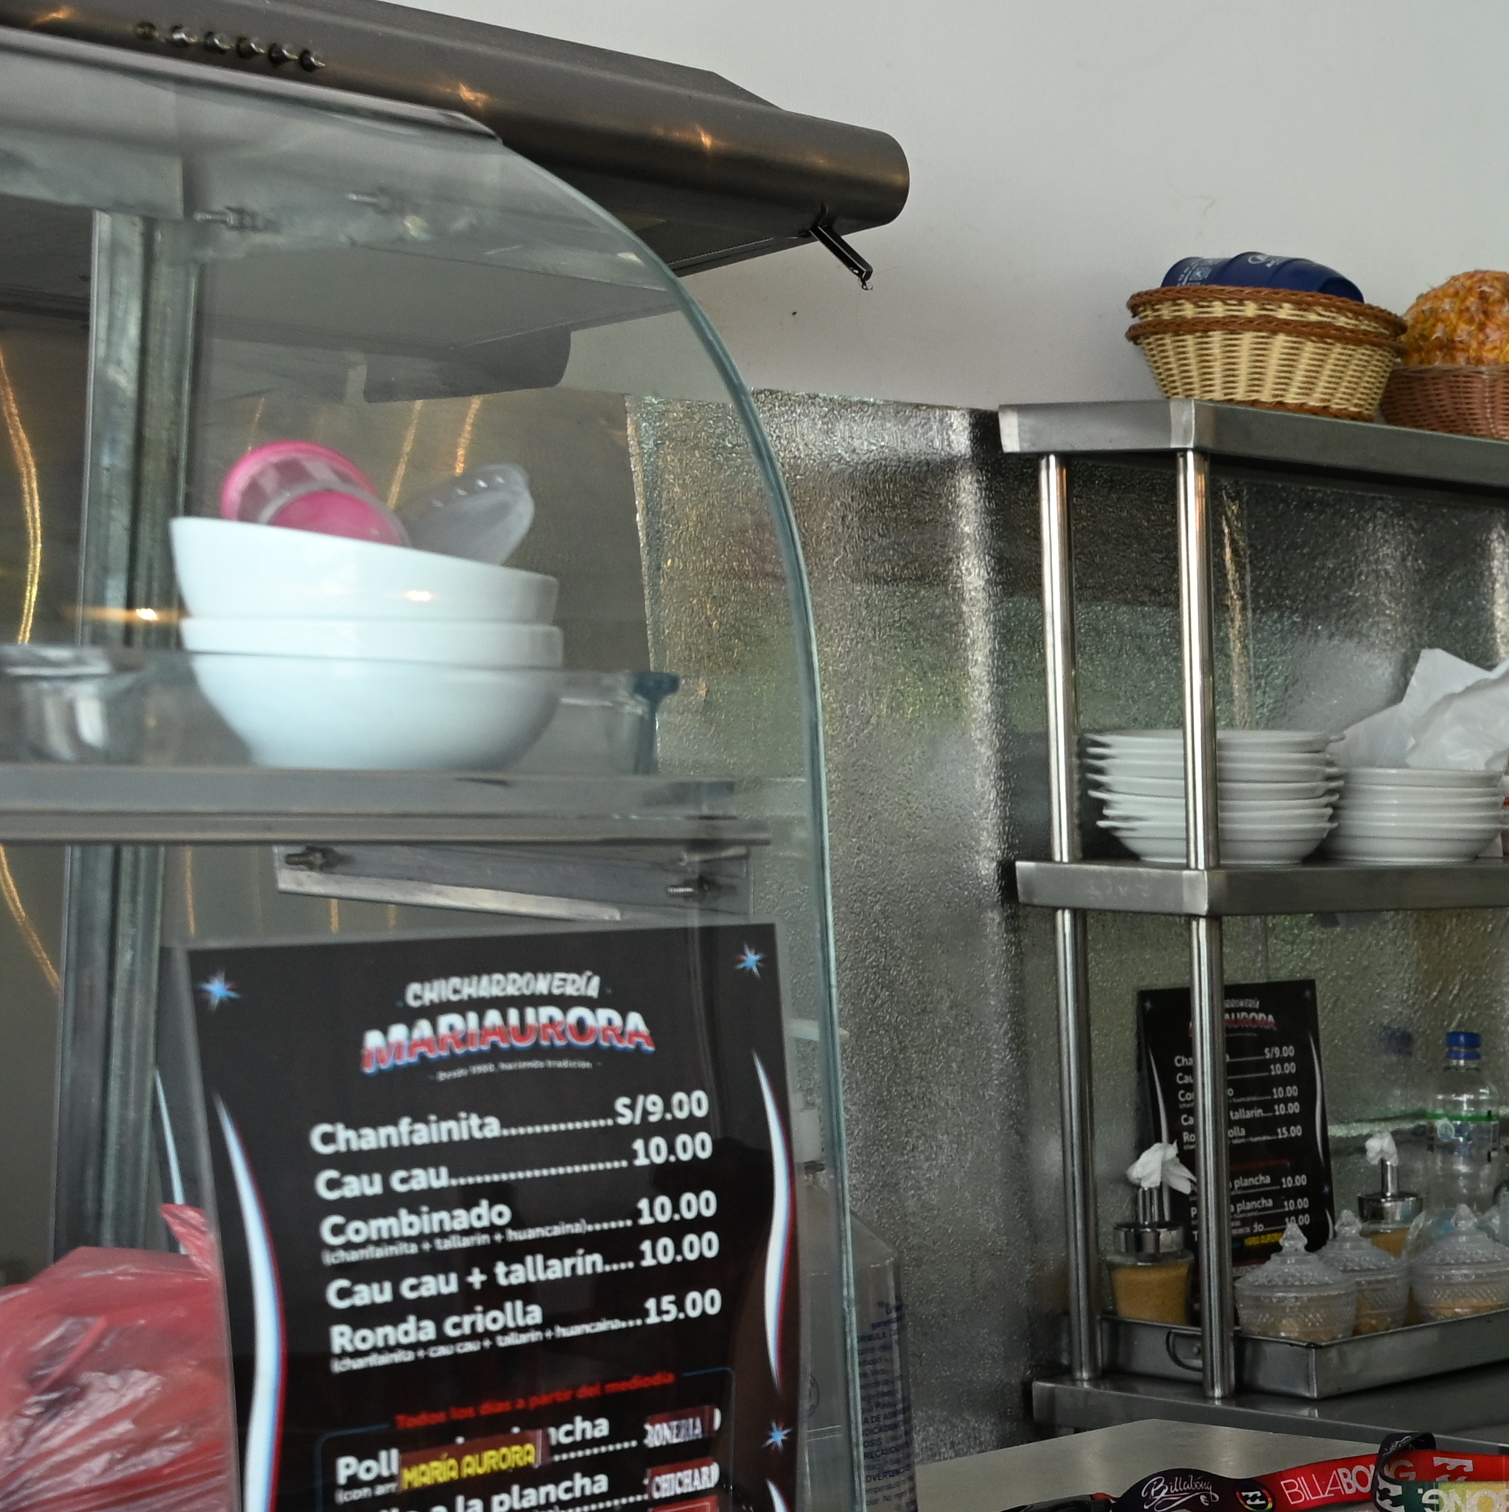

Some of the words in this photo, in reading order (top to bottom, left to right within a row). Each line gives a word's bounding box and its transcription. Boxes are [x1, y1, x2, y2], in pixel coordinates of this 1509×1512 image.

[361, 1005, 656, 1075] MARIAURORA
[1264, 1045, 1296, 1060] S/9.00
[1270, 1062, 1297, 1076] 10.00
[1272, 1085, 1299, 1099] 10.00
[1274, 1102, 1300, 1116] 10.00
[309, 1111, 501, 1155] Chanfainita
[614, 1089, 709, 1125] S/9.00
[1277, 1125, 1303, 1139] 15.00
[314, 1168, 384, 1200] Cau
[389, 1165, 449, 1192] cau
[632, 1131, 713, 1166] 10.00
[1234, 1174, 1271, 1189] plancha
[1281, 1174, 1307, 1189] 10.00
[319, 1198, 512, 1246] Combinado
[637, 1190, 717, 1225] 10.00
[1236, 1197, 1273, 1214] plancha
[1284, 1197, 1309, 1212] 10.00
[325, 1278, 393, 1309] Cau
[400, 1272, 459, 1299] cau
[466, 1267, 488, 1290] +
[640, 1231, 719, 1267] 10.00
[644, 1288, 722, 1325] 15.00
[329, 1314, 436, 1354] Ronda
[443, 1300, 543, 1337] criolla
[335, 1448, 399, 1485] Poll
[461, 1443, 536, 1478] AURORA
